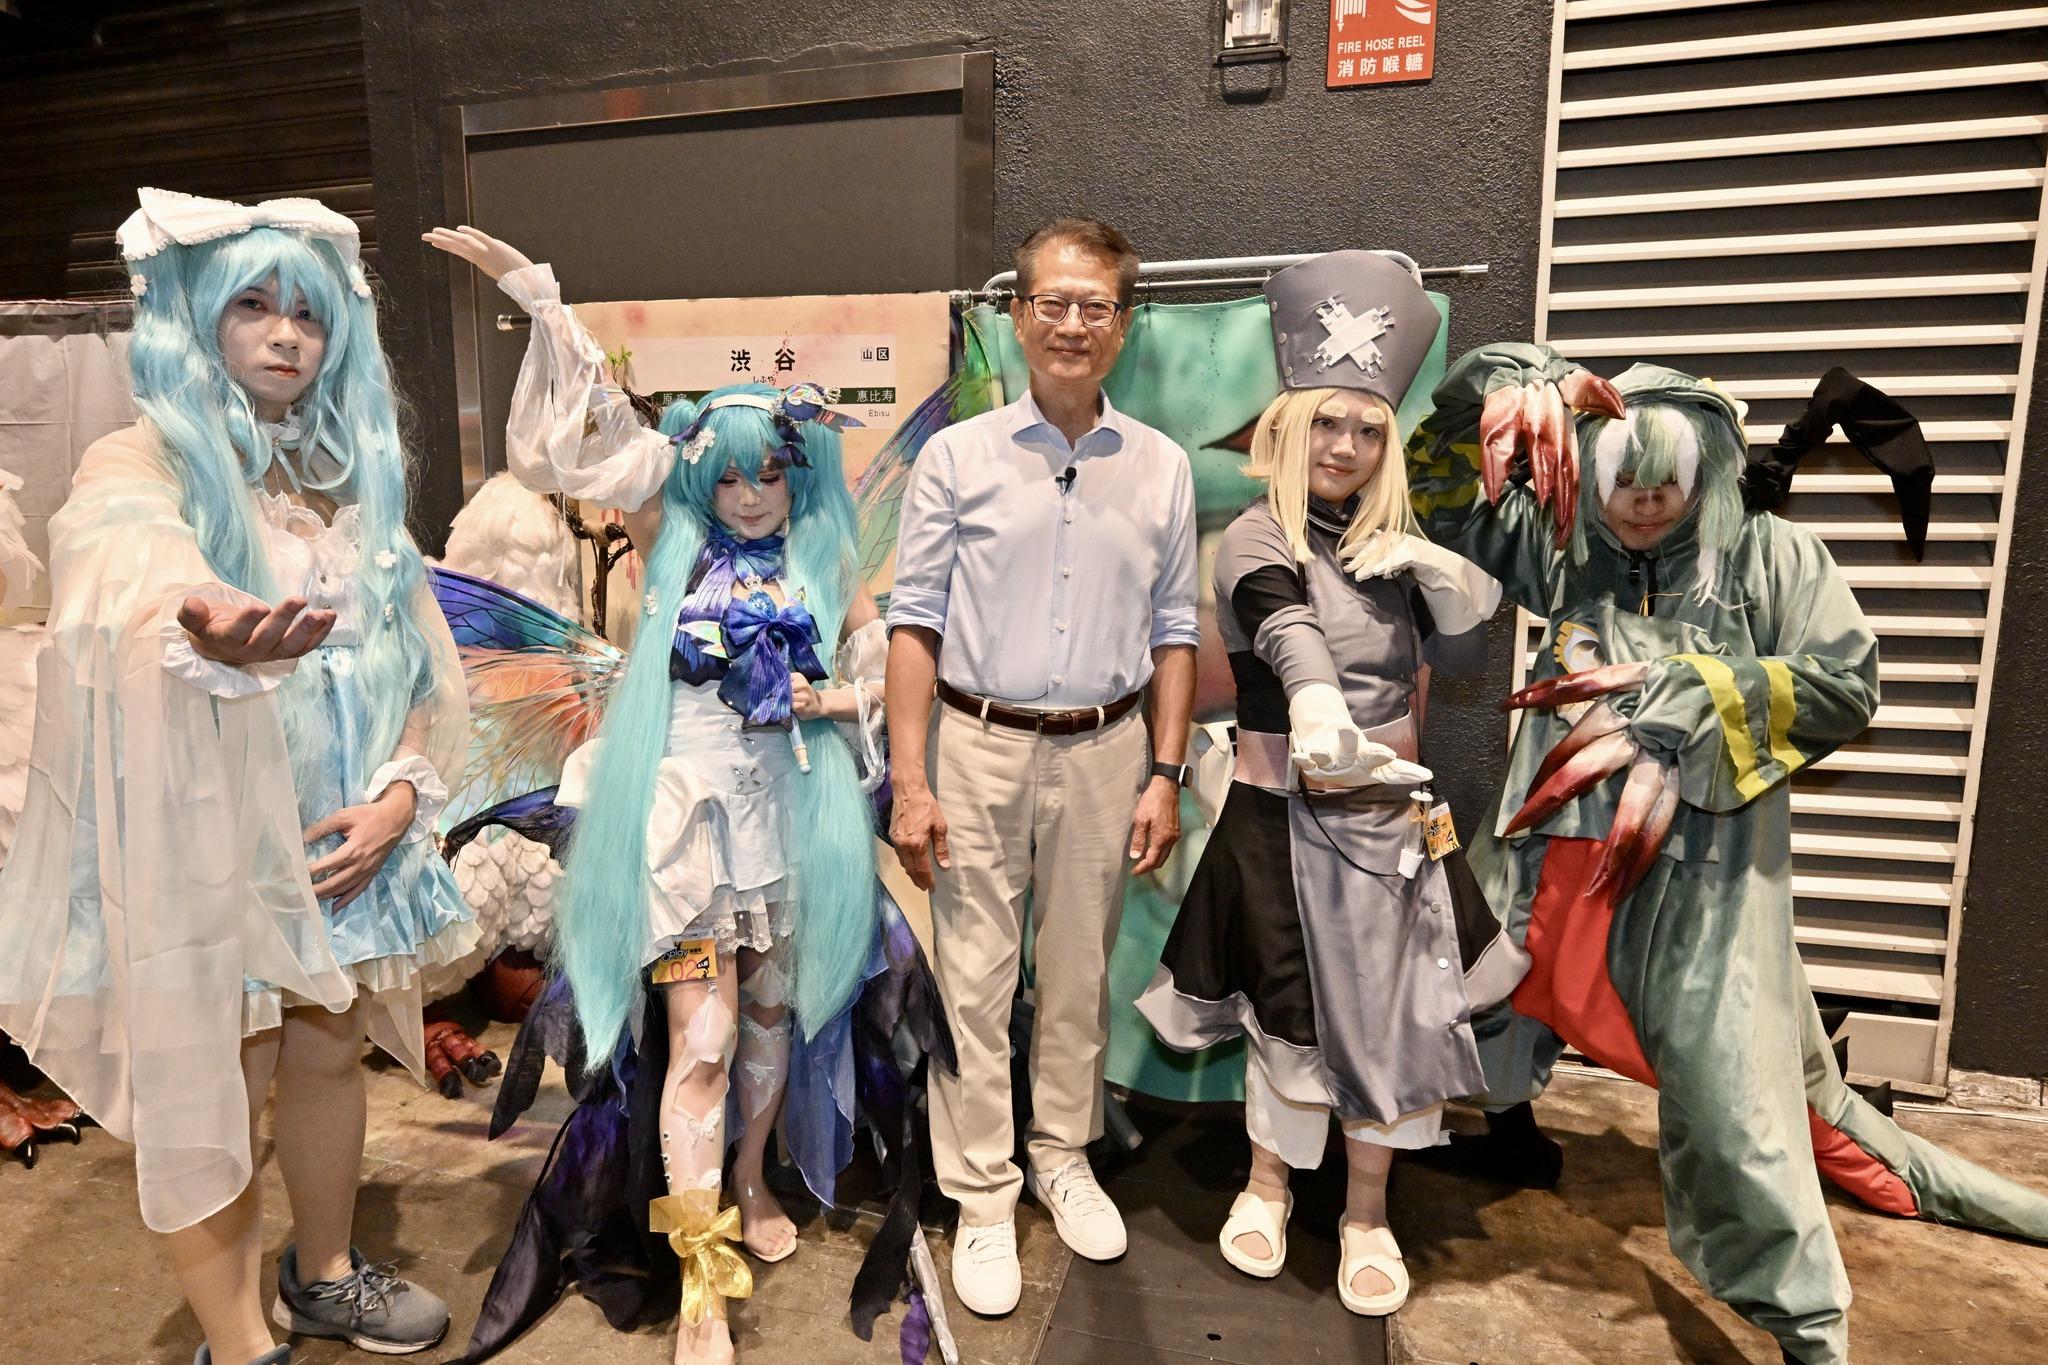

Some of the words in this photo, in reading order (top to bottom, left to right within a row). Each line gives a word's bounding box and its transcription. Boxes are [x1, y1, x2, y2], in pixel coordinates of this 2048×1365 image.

[1337, 41, 1362, 54] FIRE
[1365, 38, 1395, 52] HOSE
[1398, 35, 1425, 48] REEL
[1337, 52, 1424, 78] 消防喉轆
[730, 348, 796, 372] 渋谷
[868, 409, 890, 417] Ebisu
